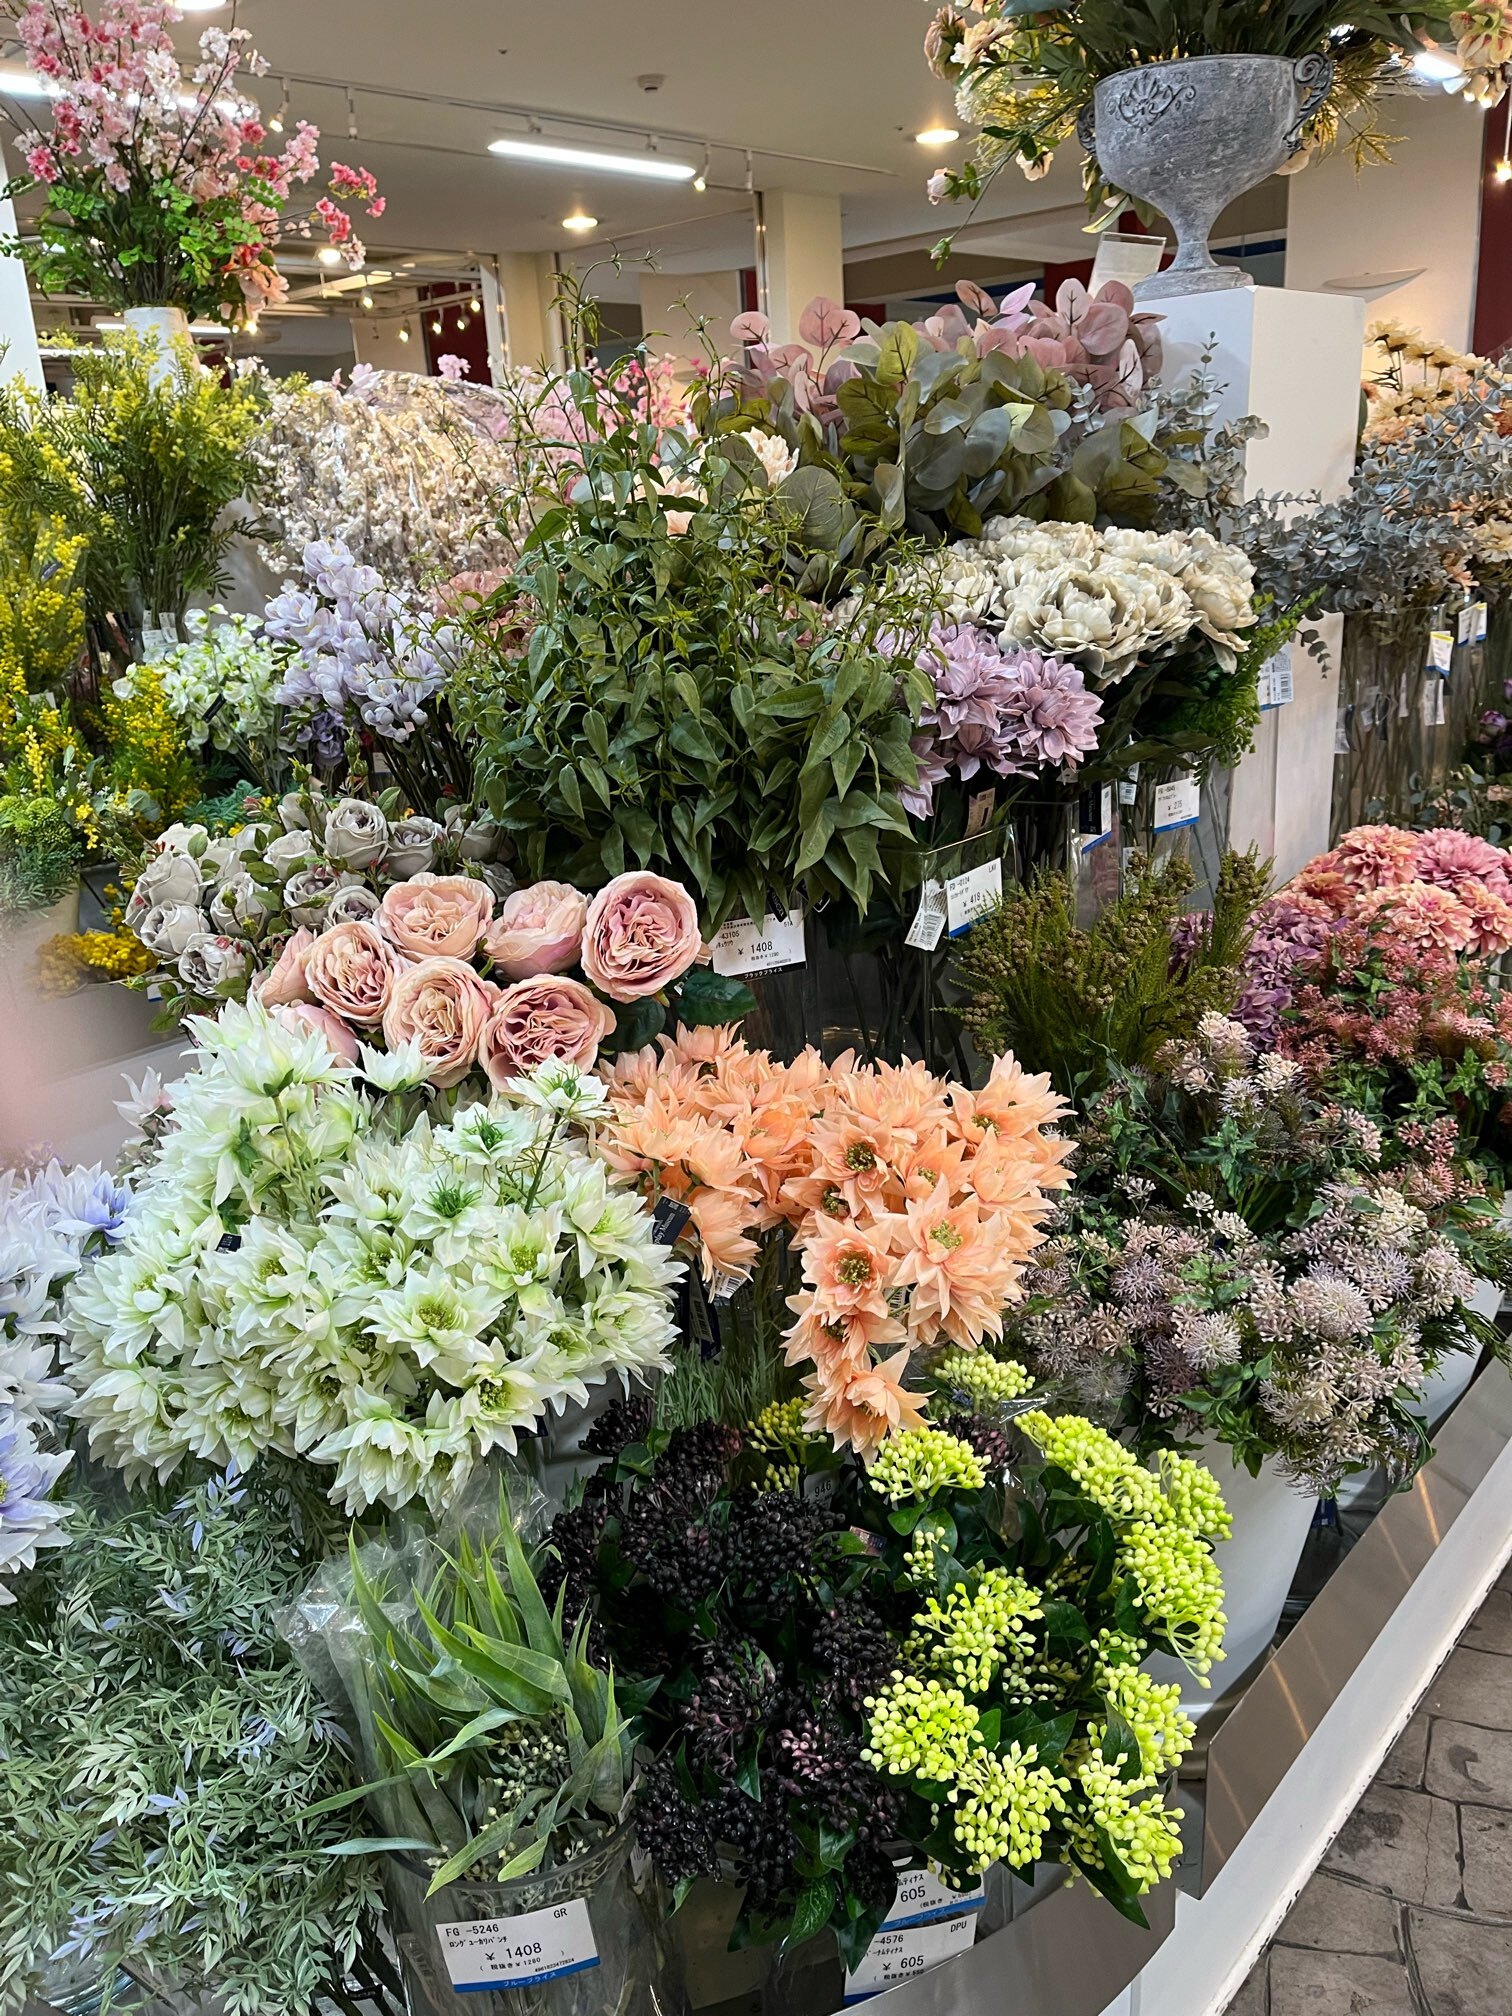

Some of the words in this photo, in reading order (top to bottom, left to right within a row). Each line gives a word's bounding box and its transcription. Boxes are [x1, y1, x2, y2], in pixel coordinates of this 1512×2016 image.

[970, 892, 980, 903] 418
[751, 941, 773, 954] 1408
[814, 1480, 832, 1497] 946
[900, 1886, 926, 1903] 605
[553, 1907, 568, 1919] GR
[445, 1927, 460, 1937] FG
[466, 1923, 499, 1936] -5246
[950, 1920, 967, 1933] DPU
[874, 1934, 904, 1946] -4576
[485, 1952, 496, 1961] ¥
[506, 1942, 542, 1960] 1408
[883, 1962, 891, 1971] ¥
[900, 1955, 924, 1969] 605
